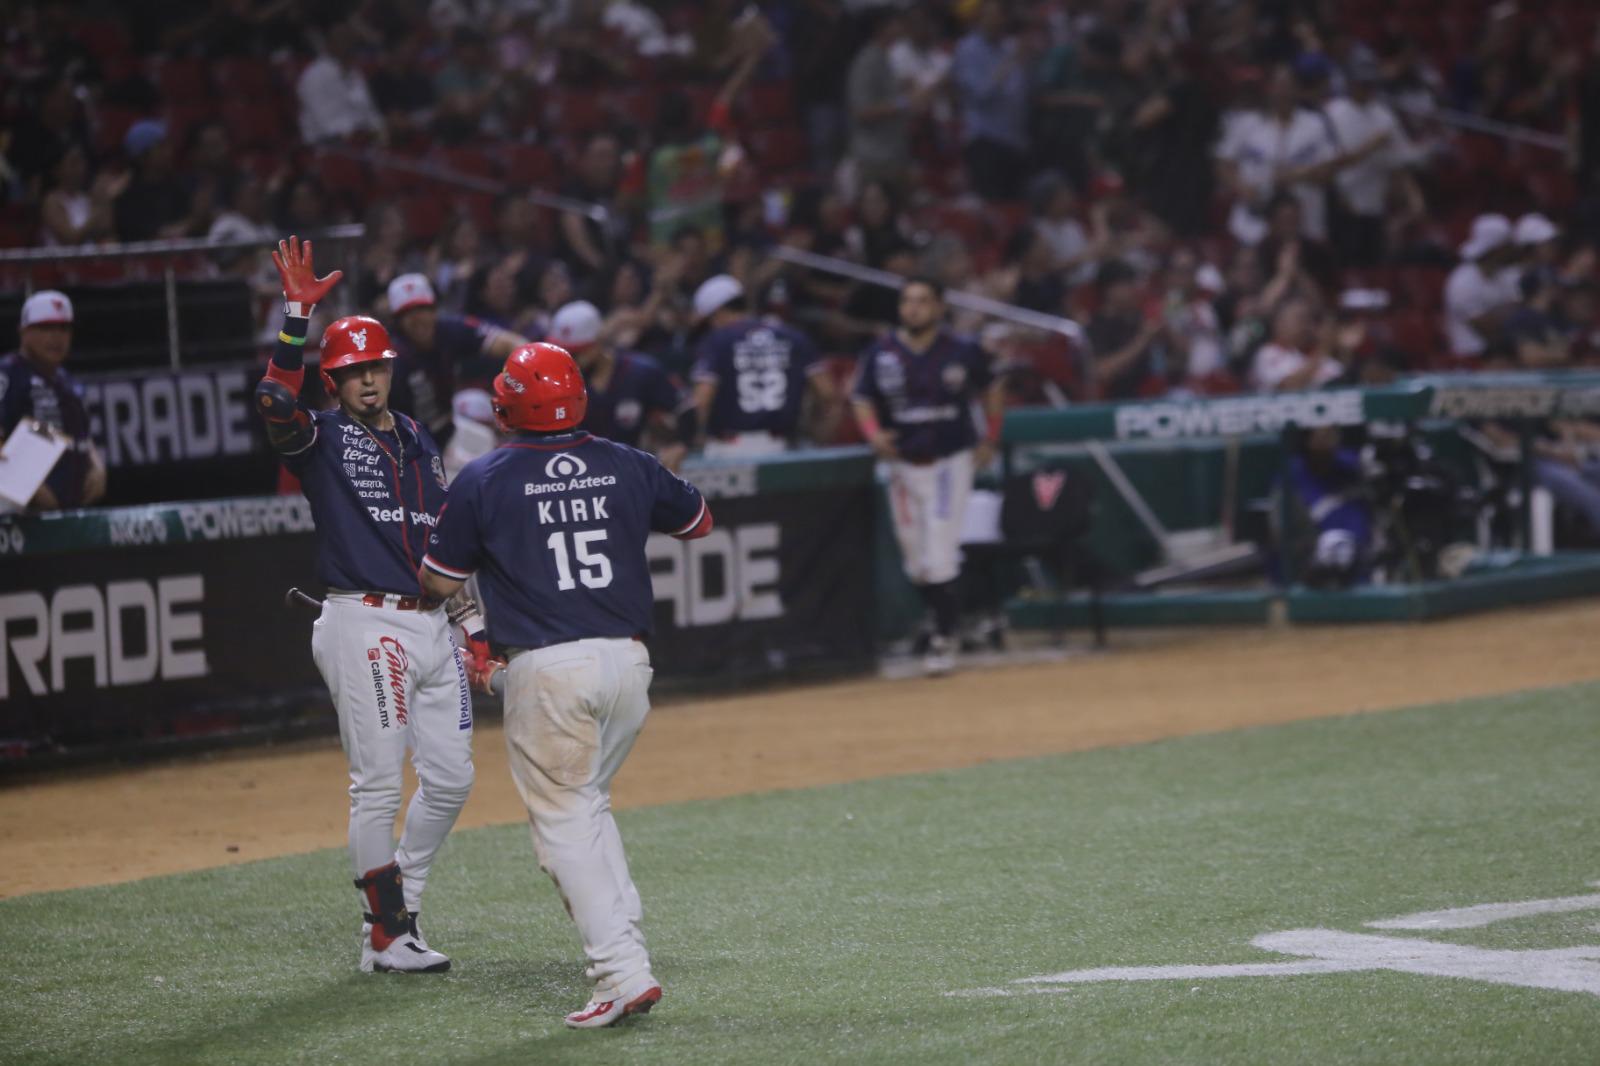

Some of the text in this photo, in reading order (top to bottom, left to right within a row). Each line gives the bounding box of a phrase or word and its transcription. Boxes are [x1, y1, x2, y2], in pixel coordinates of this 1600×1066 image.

[555, 407, 566, 420] 15
[1115, 390, 1365, 441] POWERADE
[525, 476, 616, 496] Banco Azteca
[367, 506, 405, 522] Red
[537, 496, 609, 525] KIRK
[547, 529, 613, 591] 15
[0, 574, 209, 699] RADE
[371, 661, 390, 729] caliente.mx
